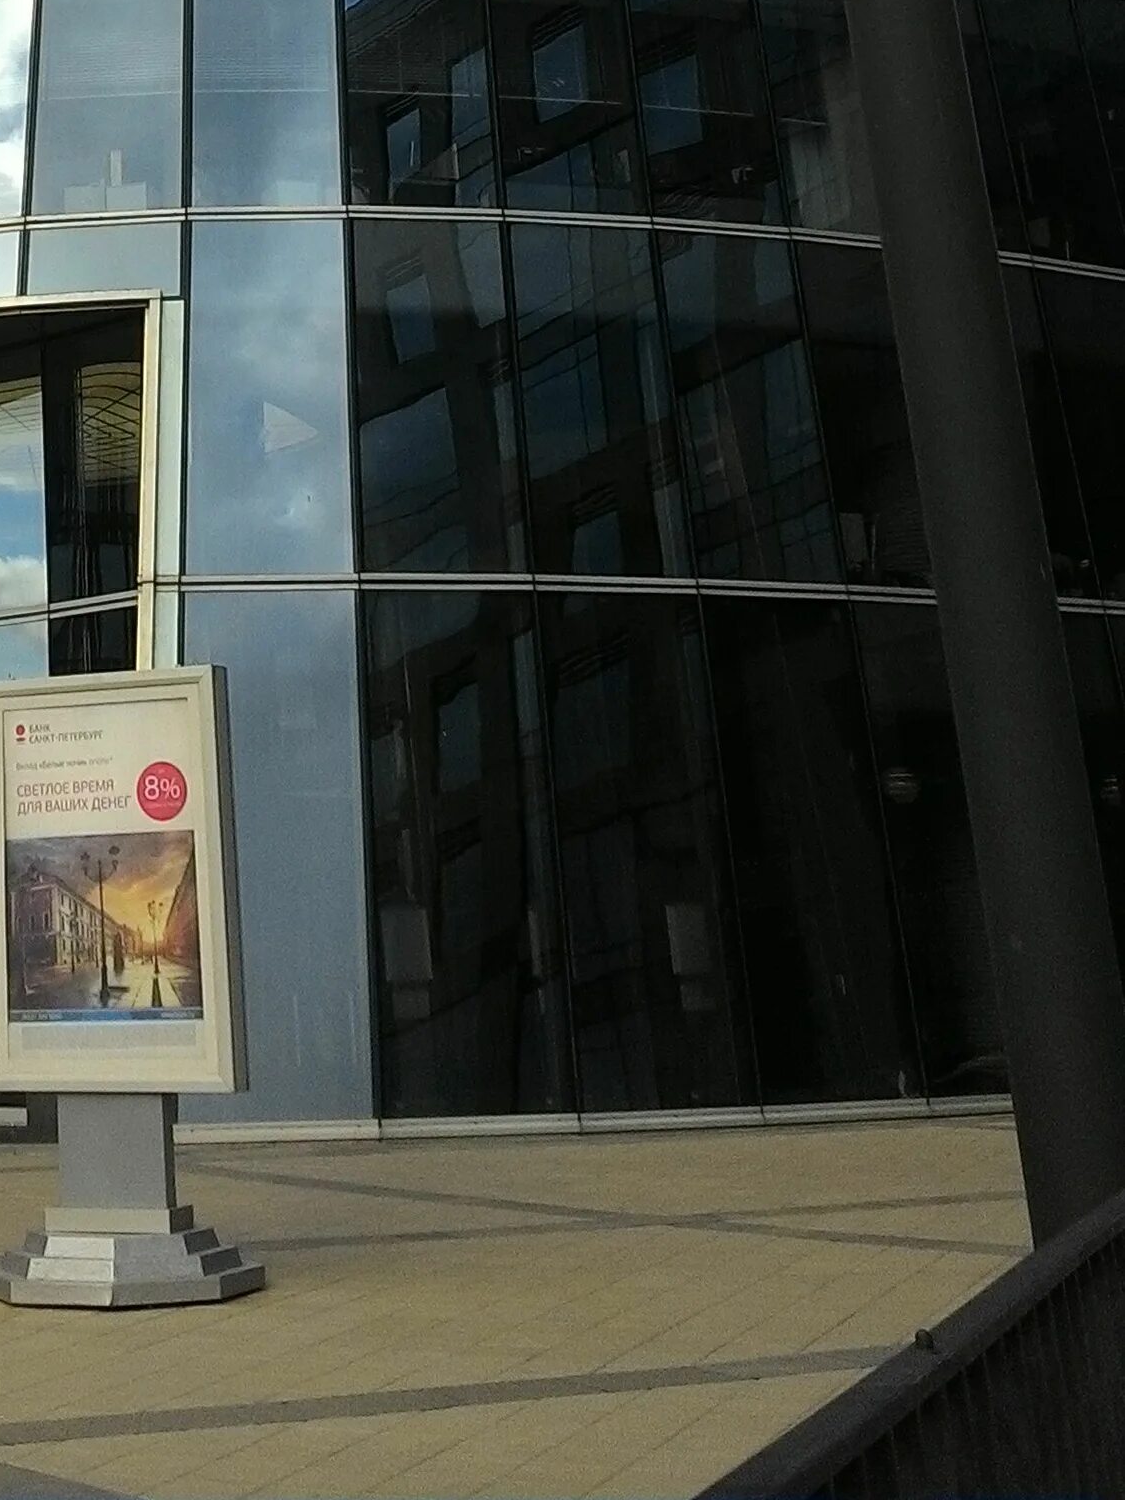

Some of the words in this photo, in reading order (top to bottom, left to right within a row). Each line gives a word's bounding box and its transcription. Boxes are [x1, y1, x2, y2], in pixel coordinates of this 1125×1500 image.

[29, 724, 51, 734] БАНК
[29, 730, 104, 744] САНКТ-ПЕТЕРБУРГ
[17, 781, 70, 798] СВЕТЛОЕ
[73, 778, 114, 794] ВРЕМЯ
[144, 774, 181, 801] 8%
[17, 800, 43, 816] ДЛЯ
[45, 797, 89, 813] ВАШИХ
[91, 795, 132, 812] ДЕНЕГ
